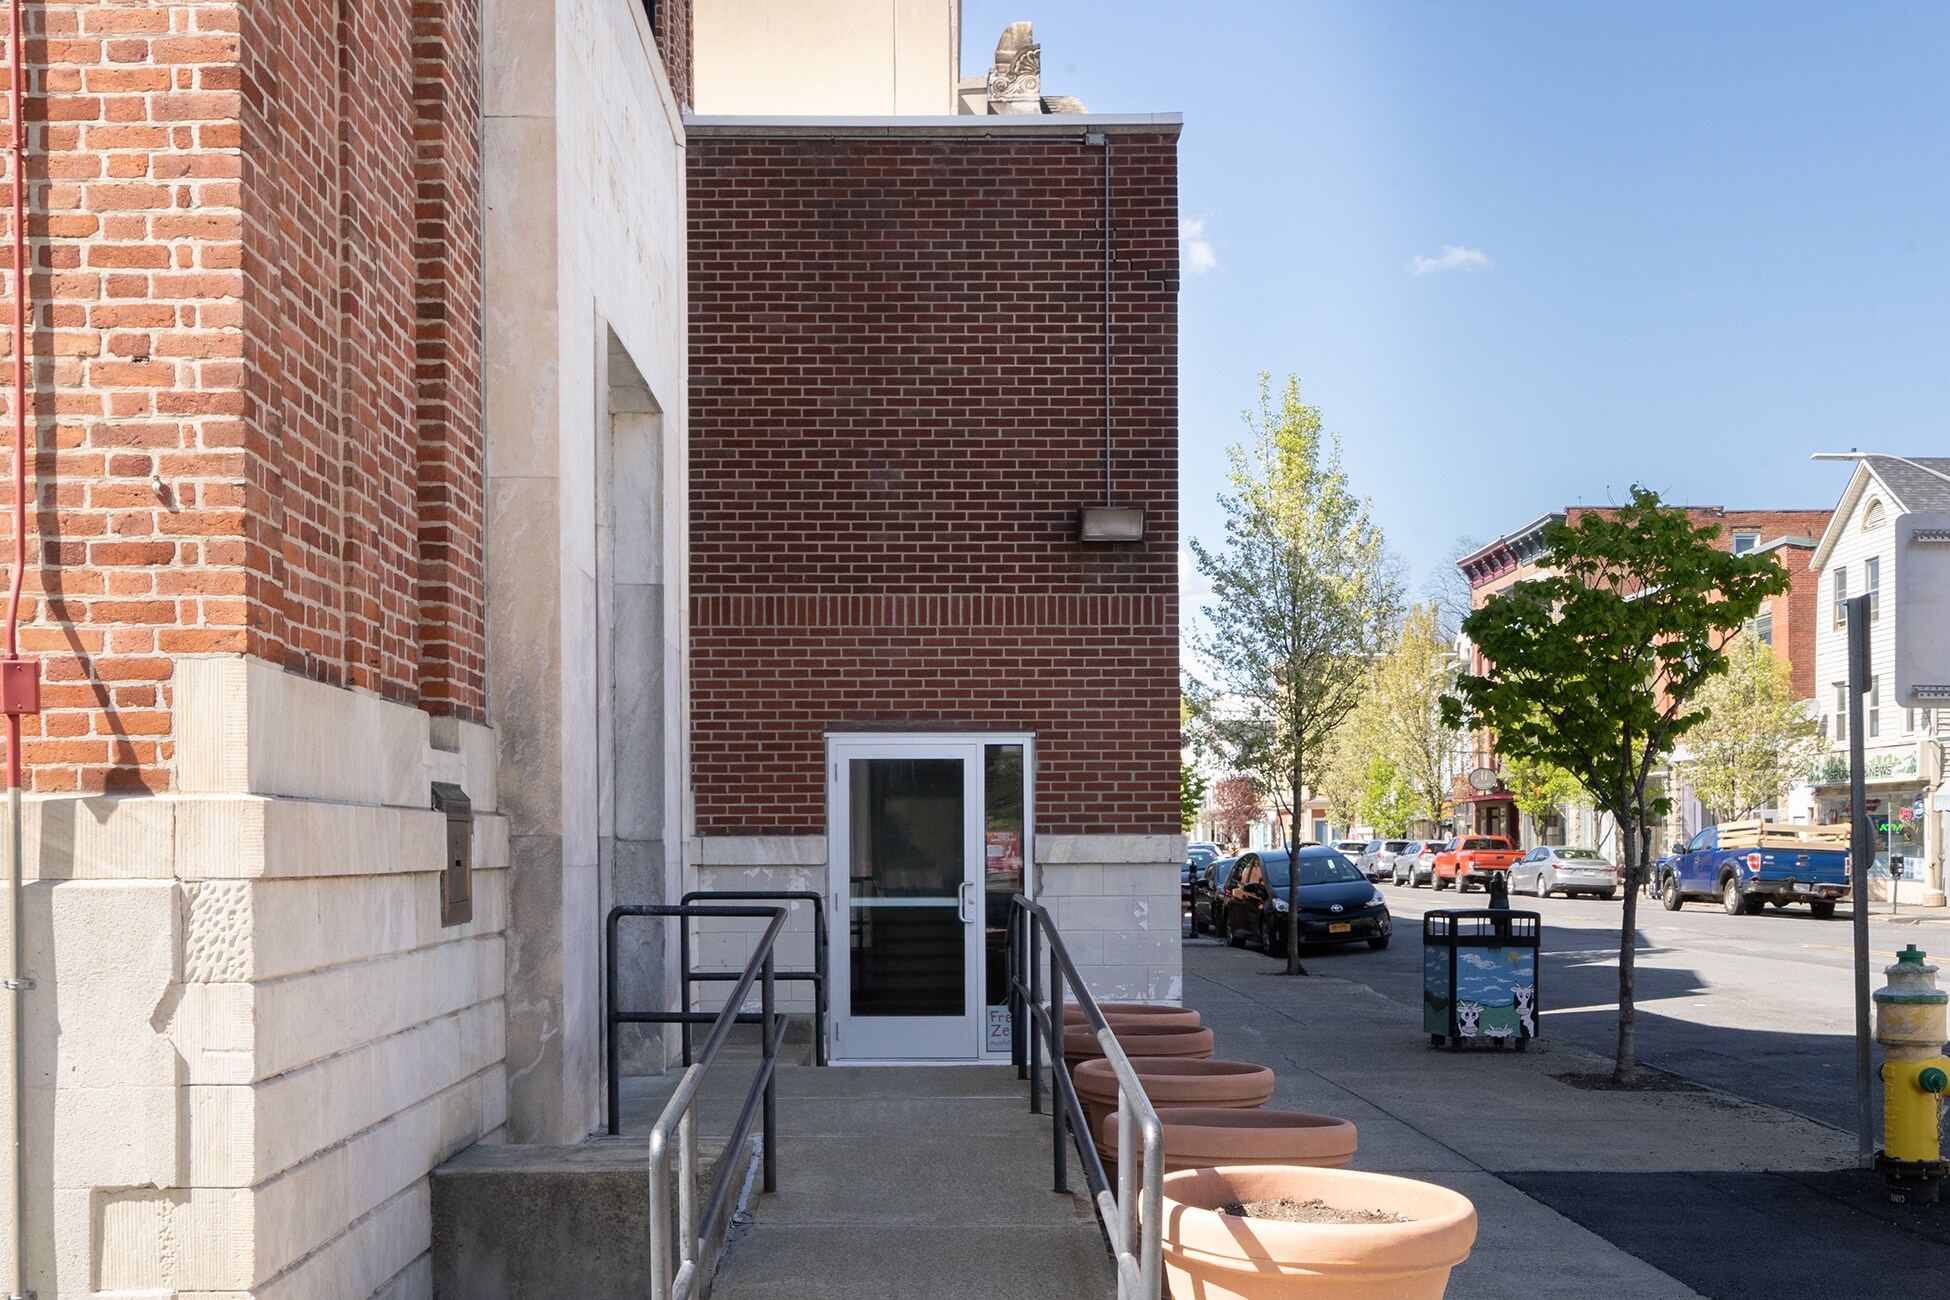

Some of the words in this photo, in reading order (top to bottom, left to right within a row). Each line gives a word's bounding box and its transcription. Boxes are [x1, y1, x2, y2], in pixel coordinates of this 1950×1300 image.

[1870, 765, 1892, 777] NEWS
[1879, 823, 1902, 832] ATM
[990, 1011, 1012, 1023] Fre
[991, 1024, 1010, 1037] Ze
